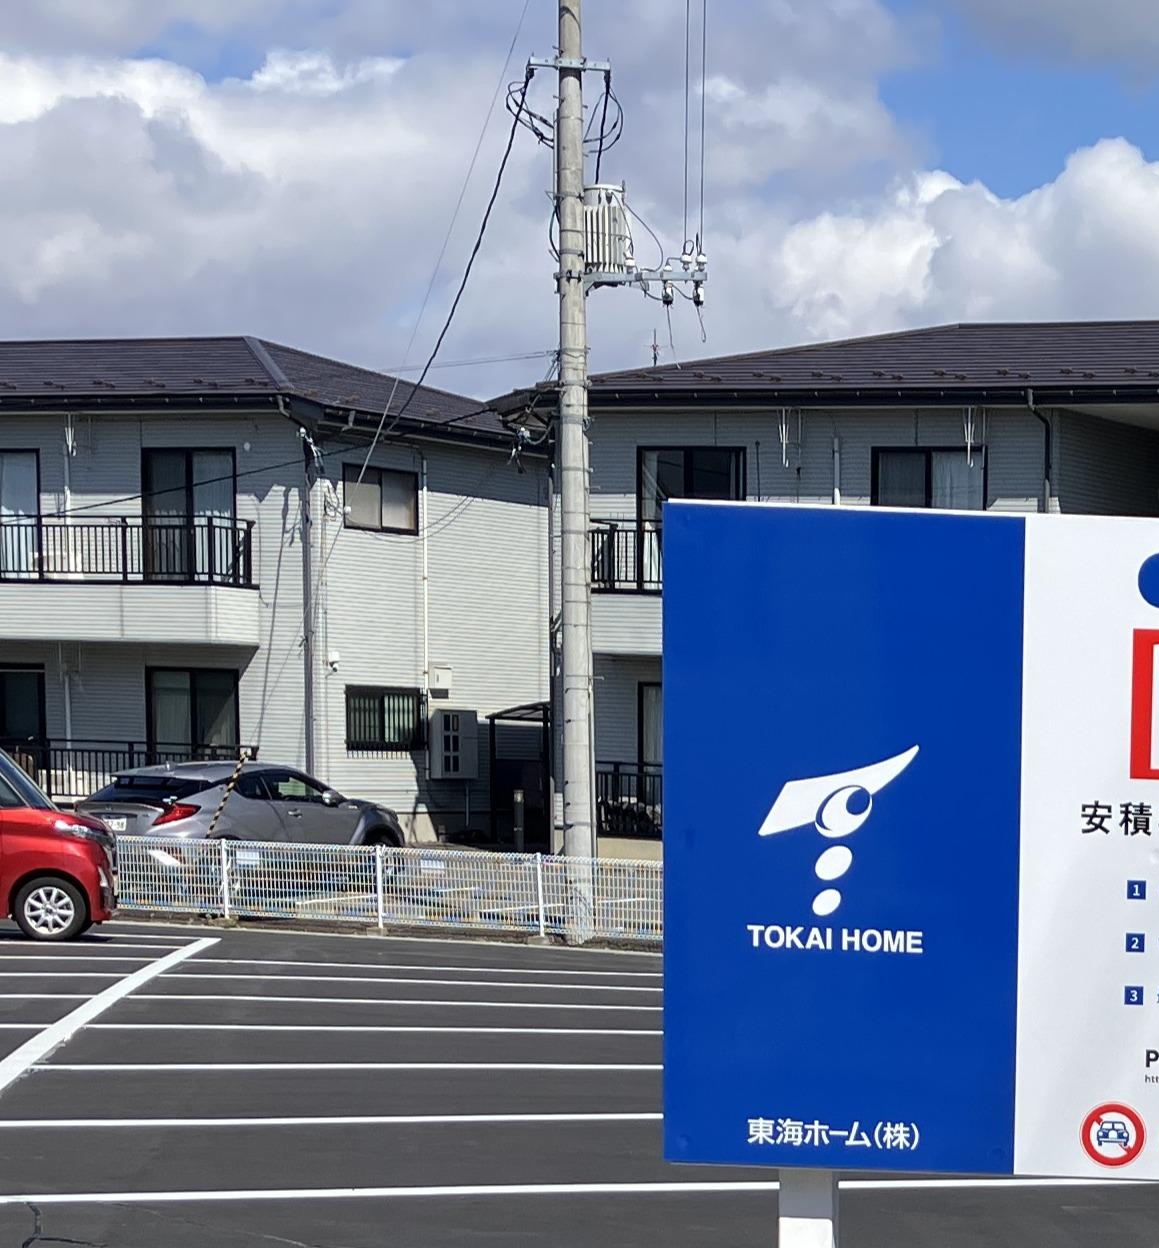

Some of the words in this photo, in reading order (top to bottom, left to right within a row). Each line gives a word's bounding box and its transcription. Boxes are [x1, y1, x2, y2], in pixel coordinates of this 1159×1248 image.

[1132, 884, 1141, 897] 1
[747, 925, 832, 949] TOKAI
[842, 929, 922, 953] HOME
[1131, 937, 1140, 950] 2
[1129, 989, 1138, 1002] 3
[748, 1117, 919, 1150] 東海ホーム(株)
